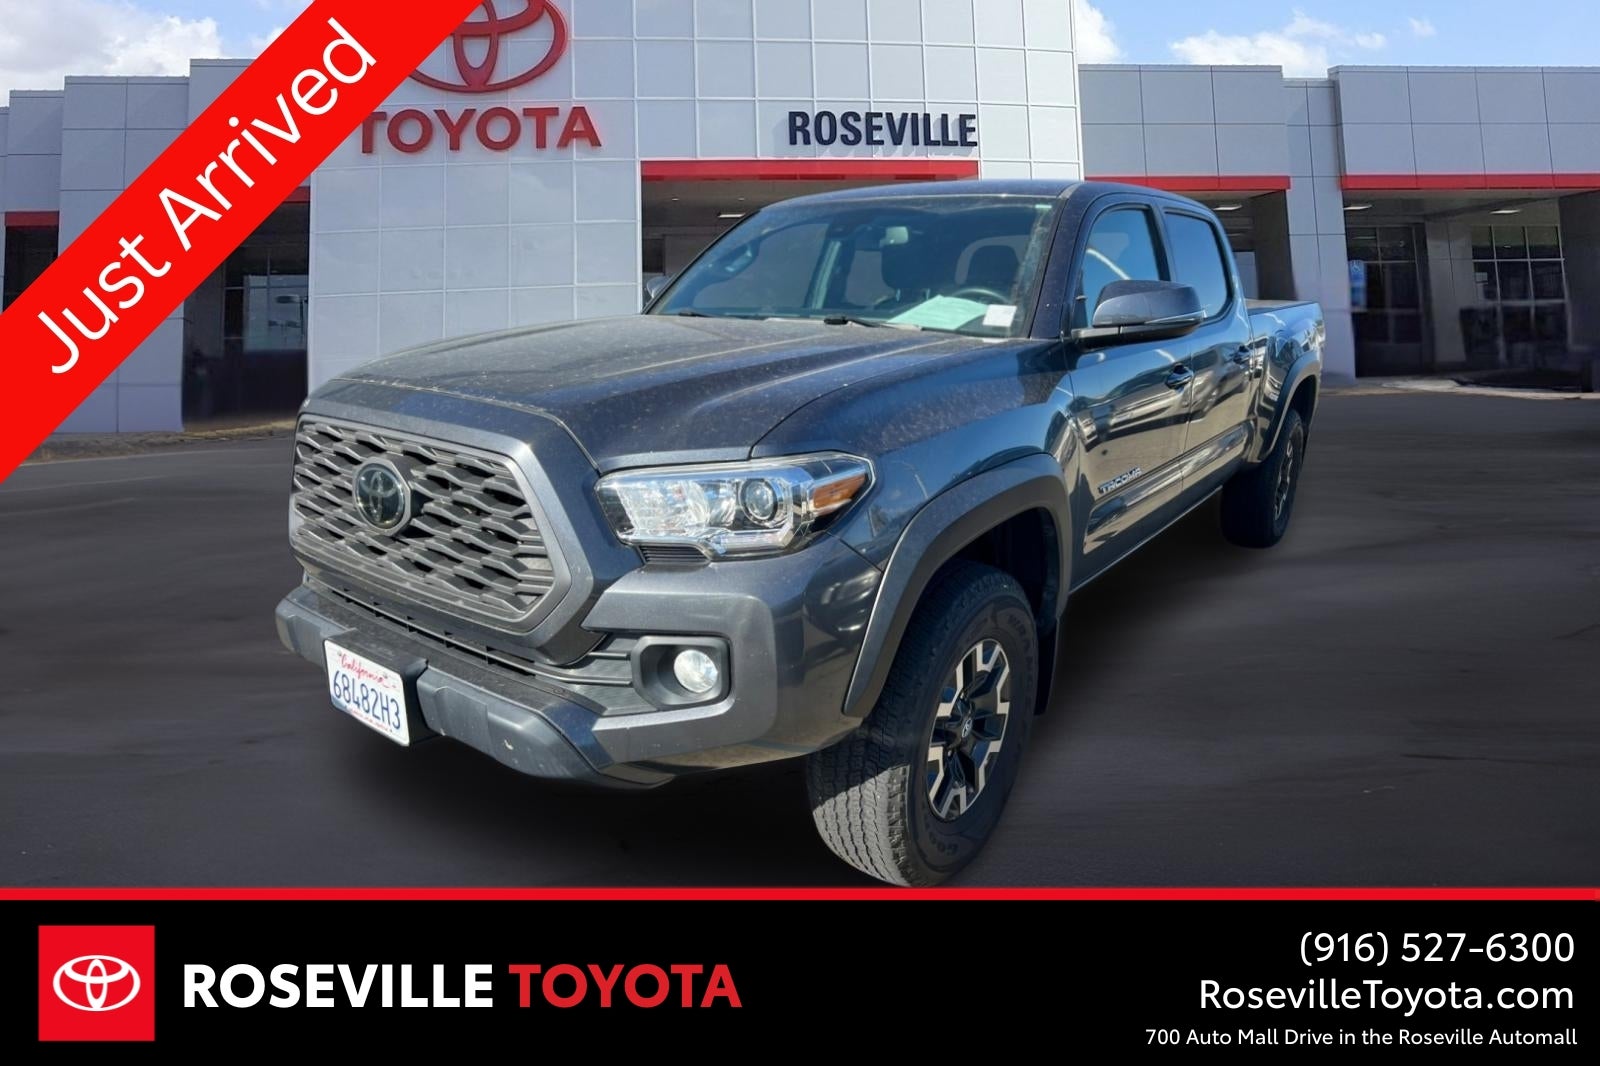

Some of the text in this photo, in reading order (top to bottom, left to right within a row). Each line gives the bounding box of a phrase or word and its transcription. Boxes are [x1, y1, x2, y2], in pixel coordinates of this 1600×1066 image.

[360, 106, 602, 153] TOYOTA
[788, 110, 978, 147] ROSEVILLE
[333, 670, 401, 730] 68482H3
